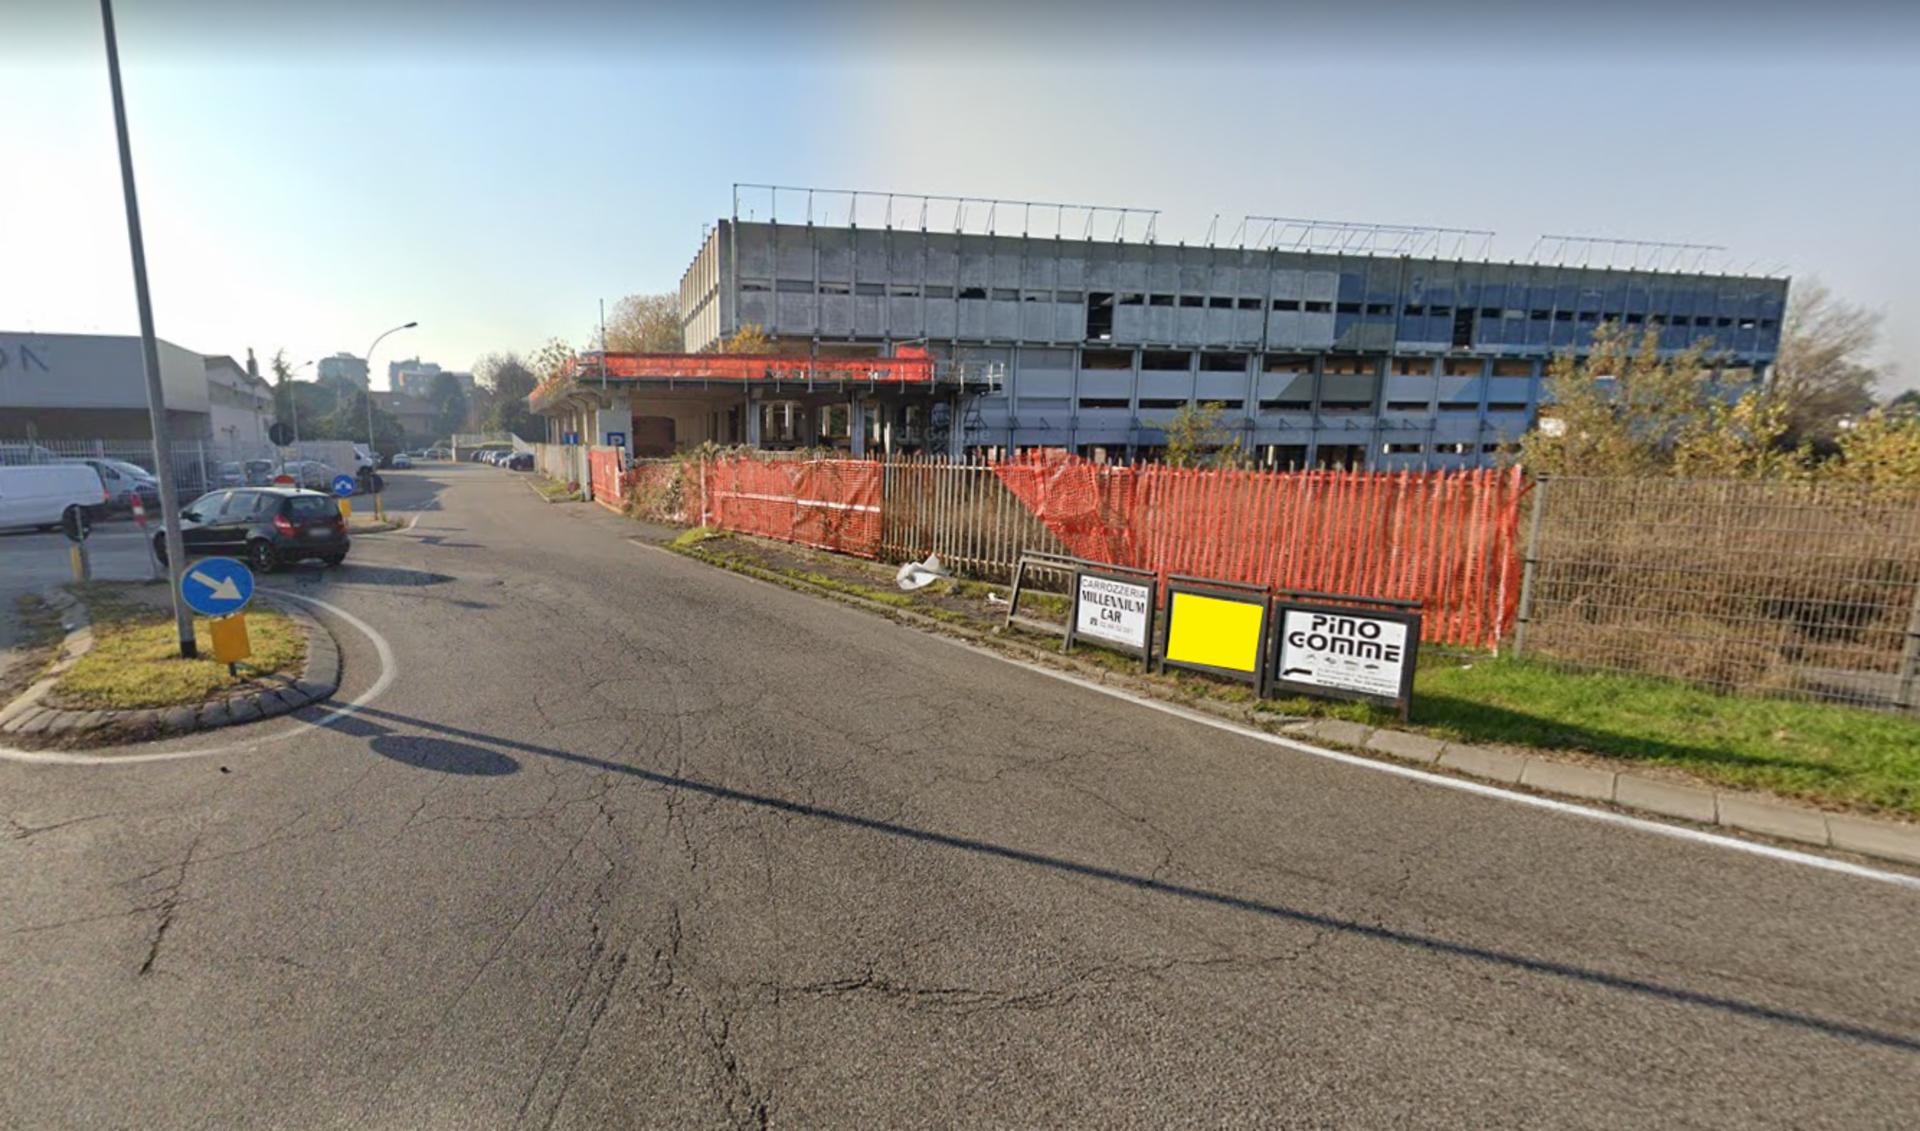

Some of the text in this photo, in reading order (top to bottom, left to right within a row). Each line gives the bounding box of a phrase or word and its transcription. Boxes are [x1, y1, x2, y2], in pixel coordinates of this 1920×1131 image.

[1081, 579, 1146, 599] CARROZZERIA
[1081, 590, 1145, 614] MILLENNIUM
[1100, 608, 1122, 624] CAR
